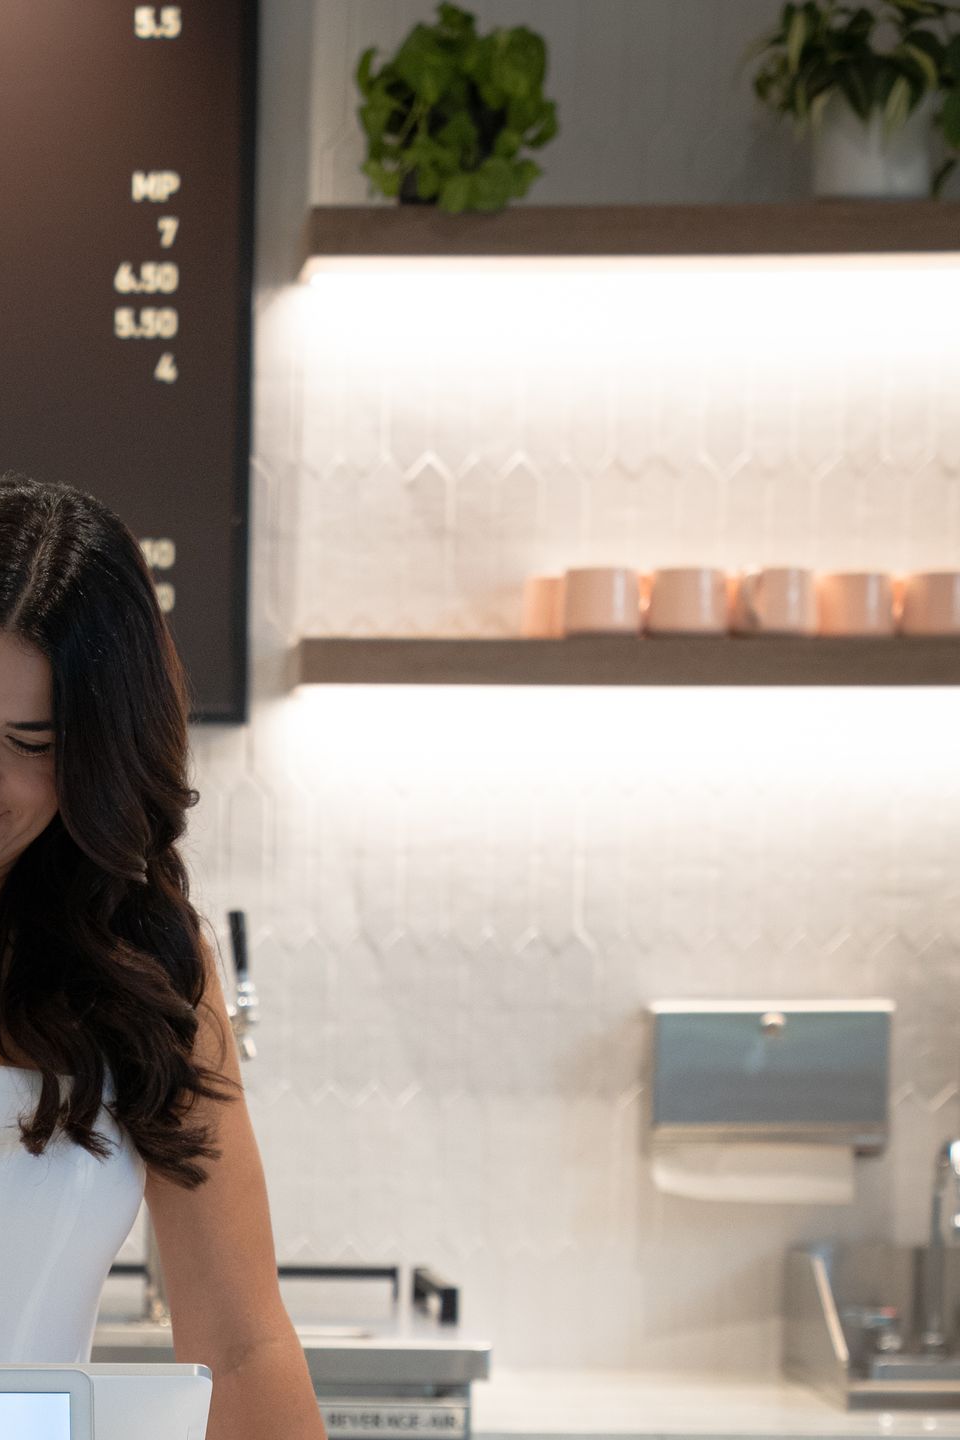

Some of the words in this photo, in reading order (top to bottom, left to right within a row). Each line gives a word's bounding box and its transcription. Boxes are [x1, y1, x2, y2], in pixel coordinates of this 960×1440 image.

[135, 7, 180, 37] 5.5
[132, 172, 179, 200] MP
[158, 218, 178, 246] 7
[115, 263, 178, 292] 6.50
[115, 308, 177, 337] 5.50
[155, 355, 176, 381] 4
